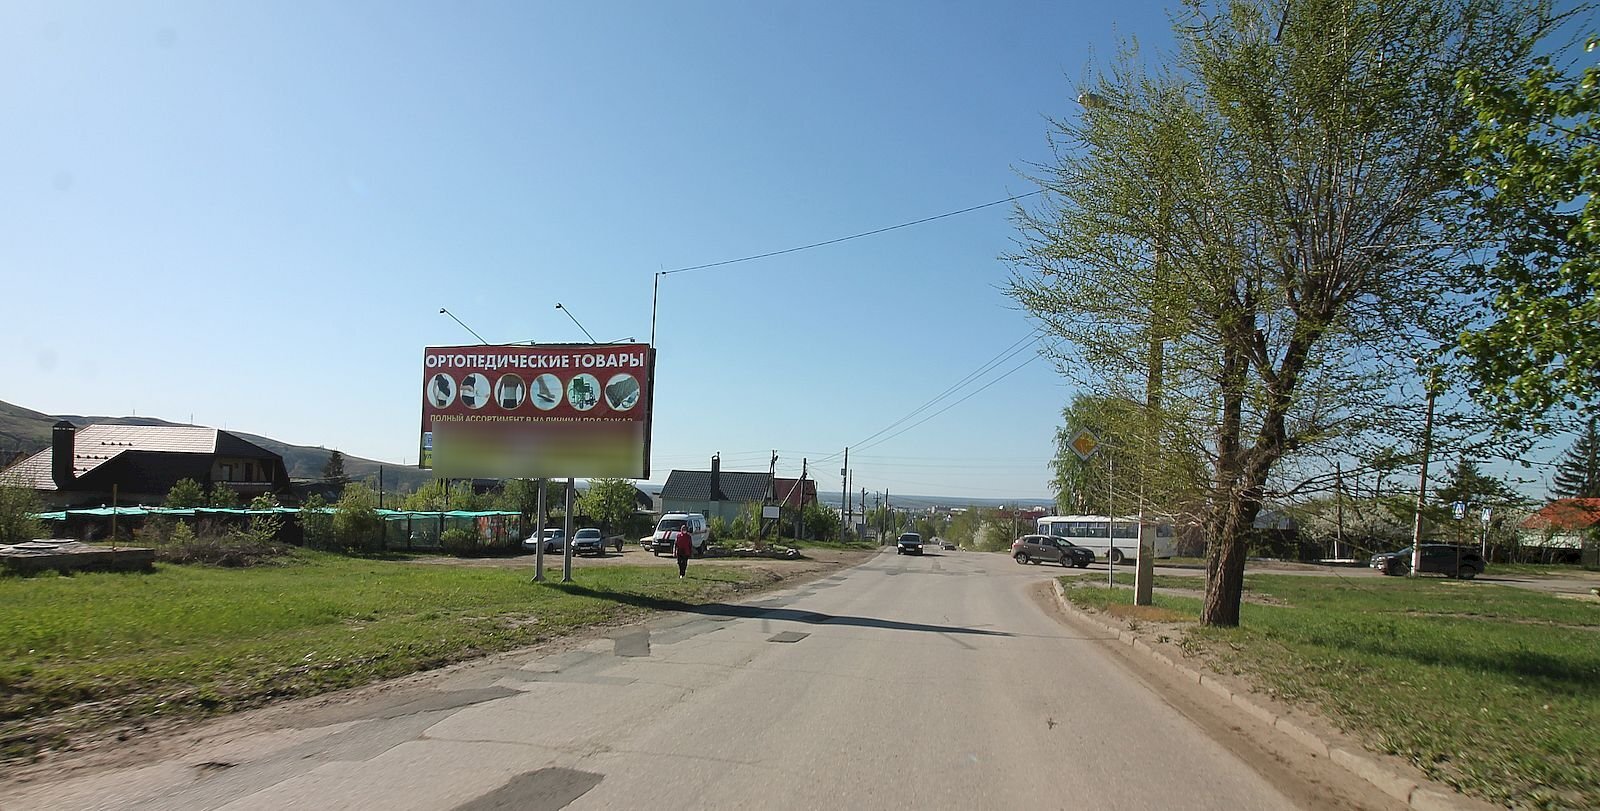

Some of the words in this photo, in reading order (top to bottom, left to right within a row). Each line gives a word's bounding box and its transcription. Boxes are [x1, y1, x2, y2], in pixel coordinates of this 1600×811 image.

[426, 354, 569, 370] ОРТОПЕДИЧЕСКИЕ
[573, 353, 643, 367] ТОВАРЫ
[430, 413, 464, 421] ПОЛНЫЙ
